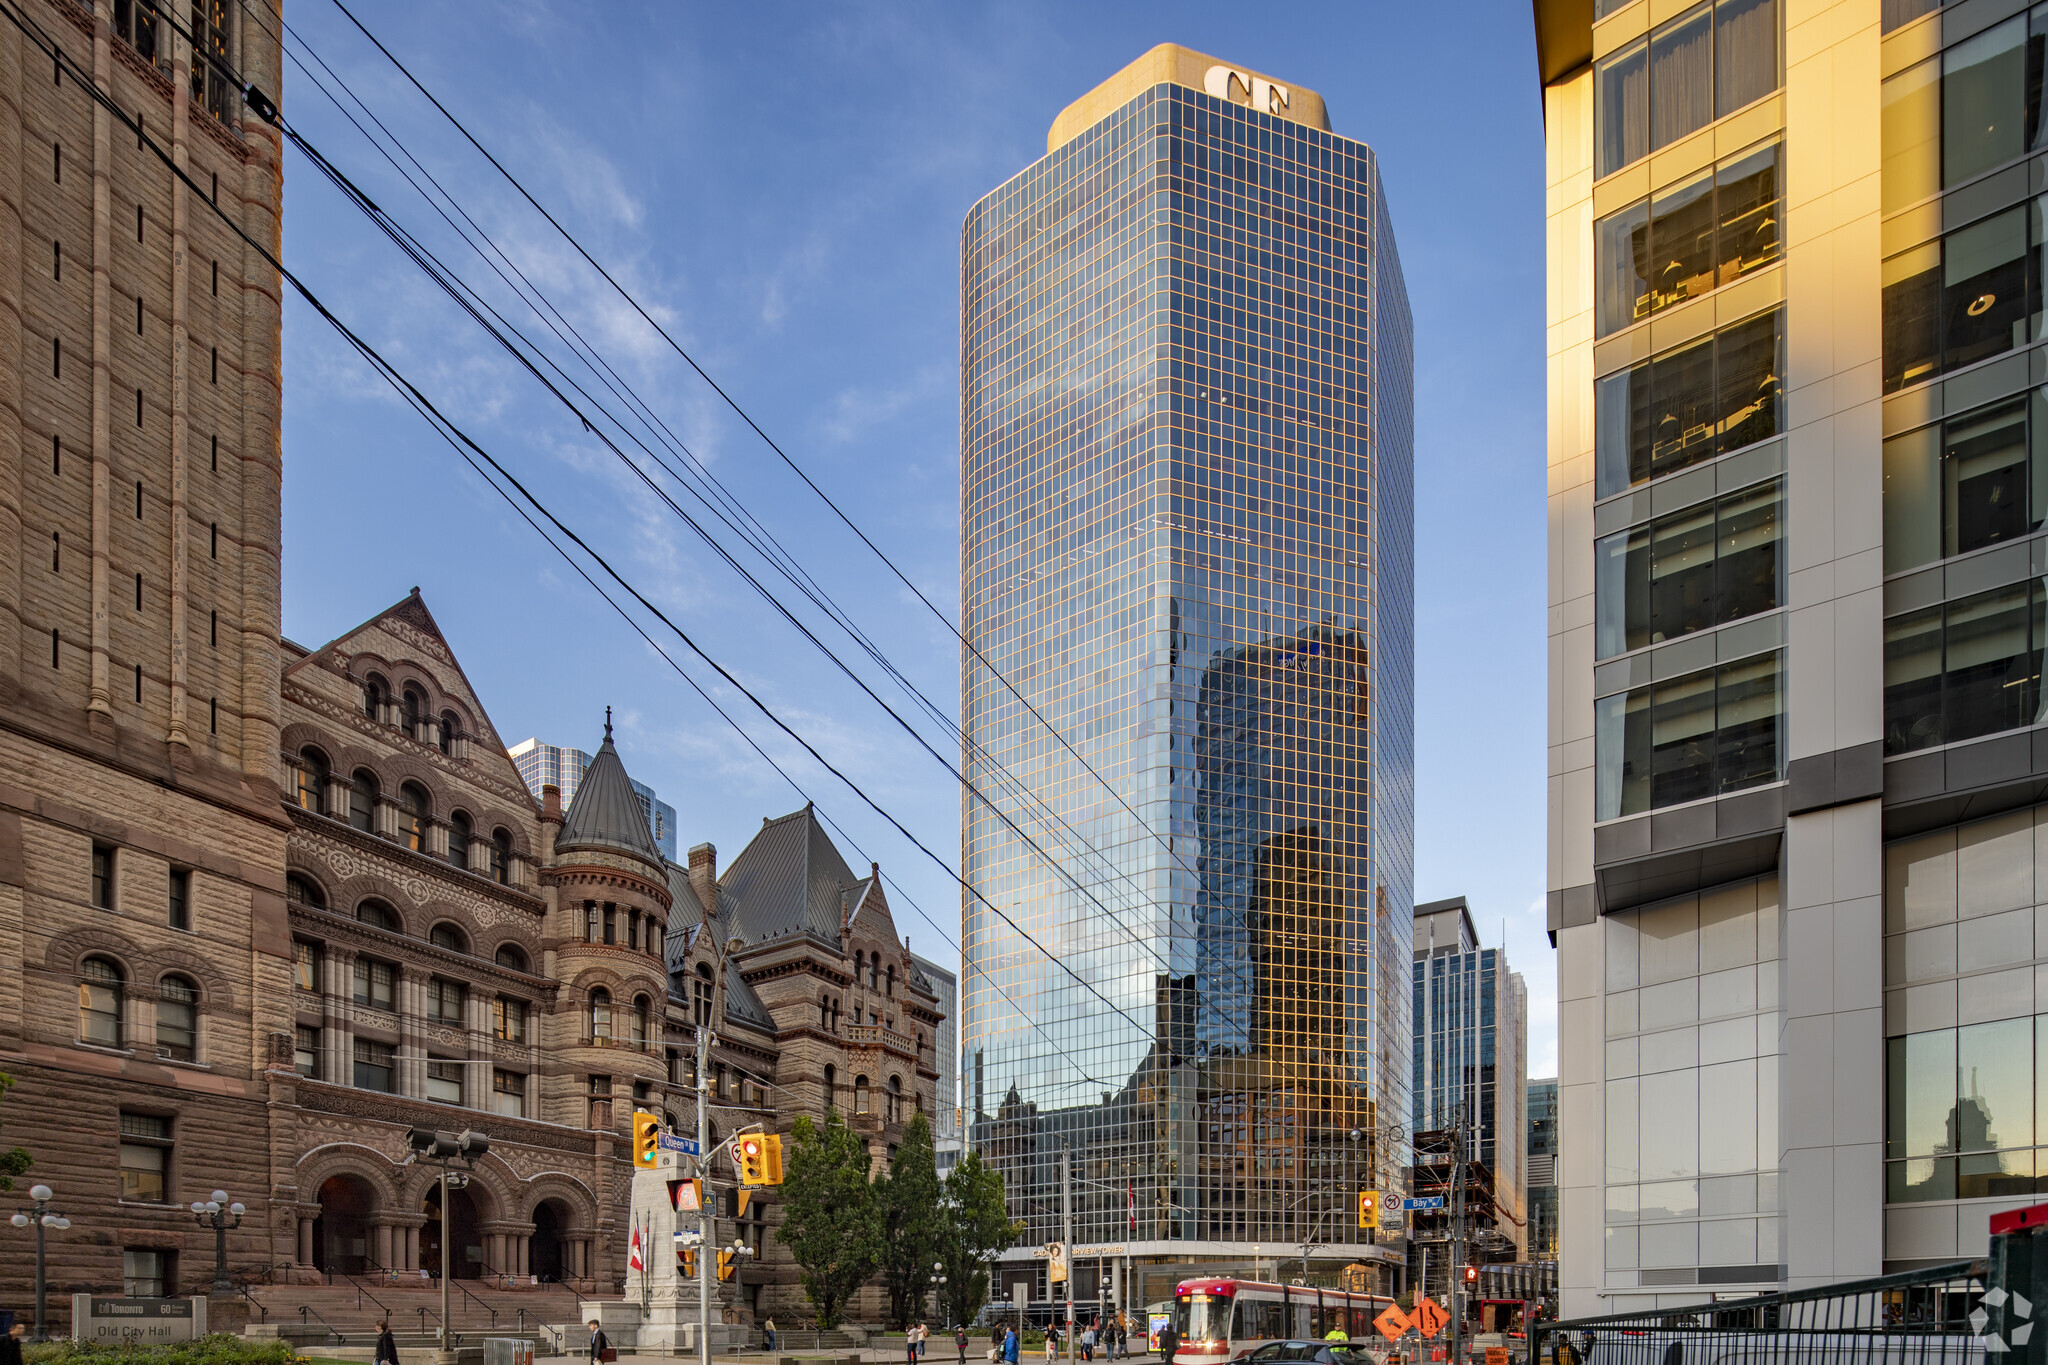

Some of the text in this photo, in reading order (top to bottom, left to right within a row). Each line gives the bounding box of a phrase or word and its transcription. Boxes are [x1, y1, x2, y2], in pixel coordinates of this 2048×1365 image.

[1203, 65, 1288, 115] CF
[665, 1135, 685, 1150] Queen
[689, 1141, 695, 1152] W
[1413, 1199, 1428, 1208] Bay
[1071, 1247, 1097, 1255] AIRVIEW
[1099, 1245, 1124, 1254] TOWER
[111, 1303, 144, 1314] TORONTO
[160, 1304, 171, 1314] 60
[98, 1326, 171, 1338] Old City Hall
